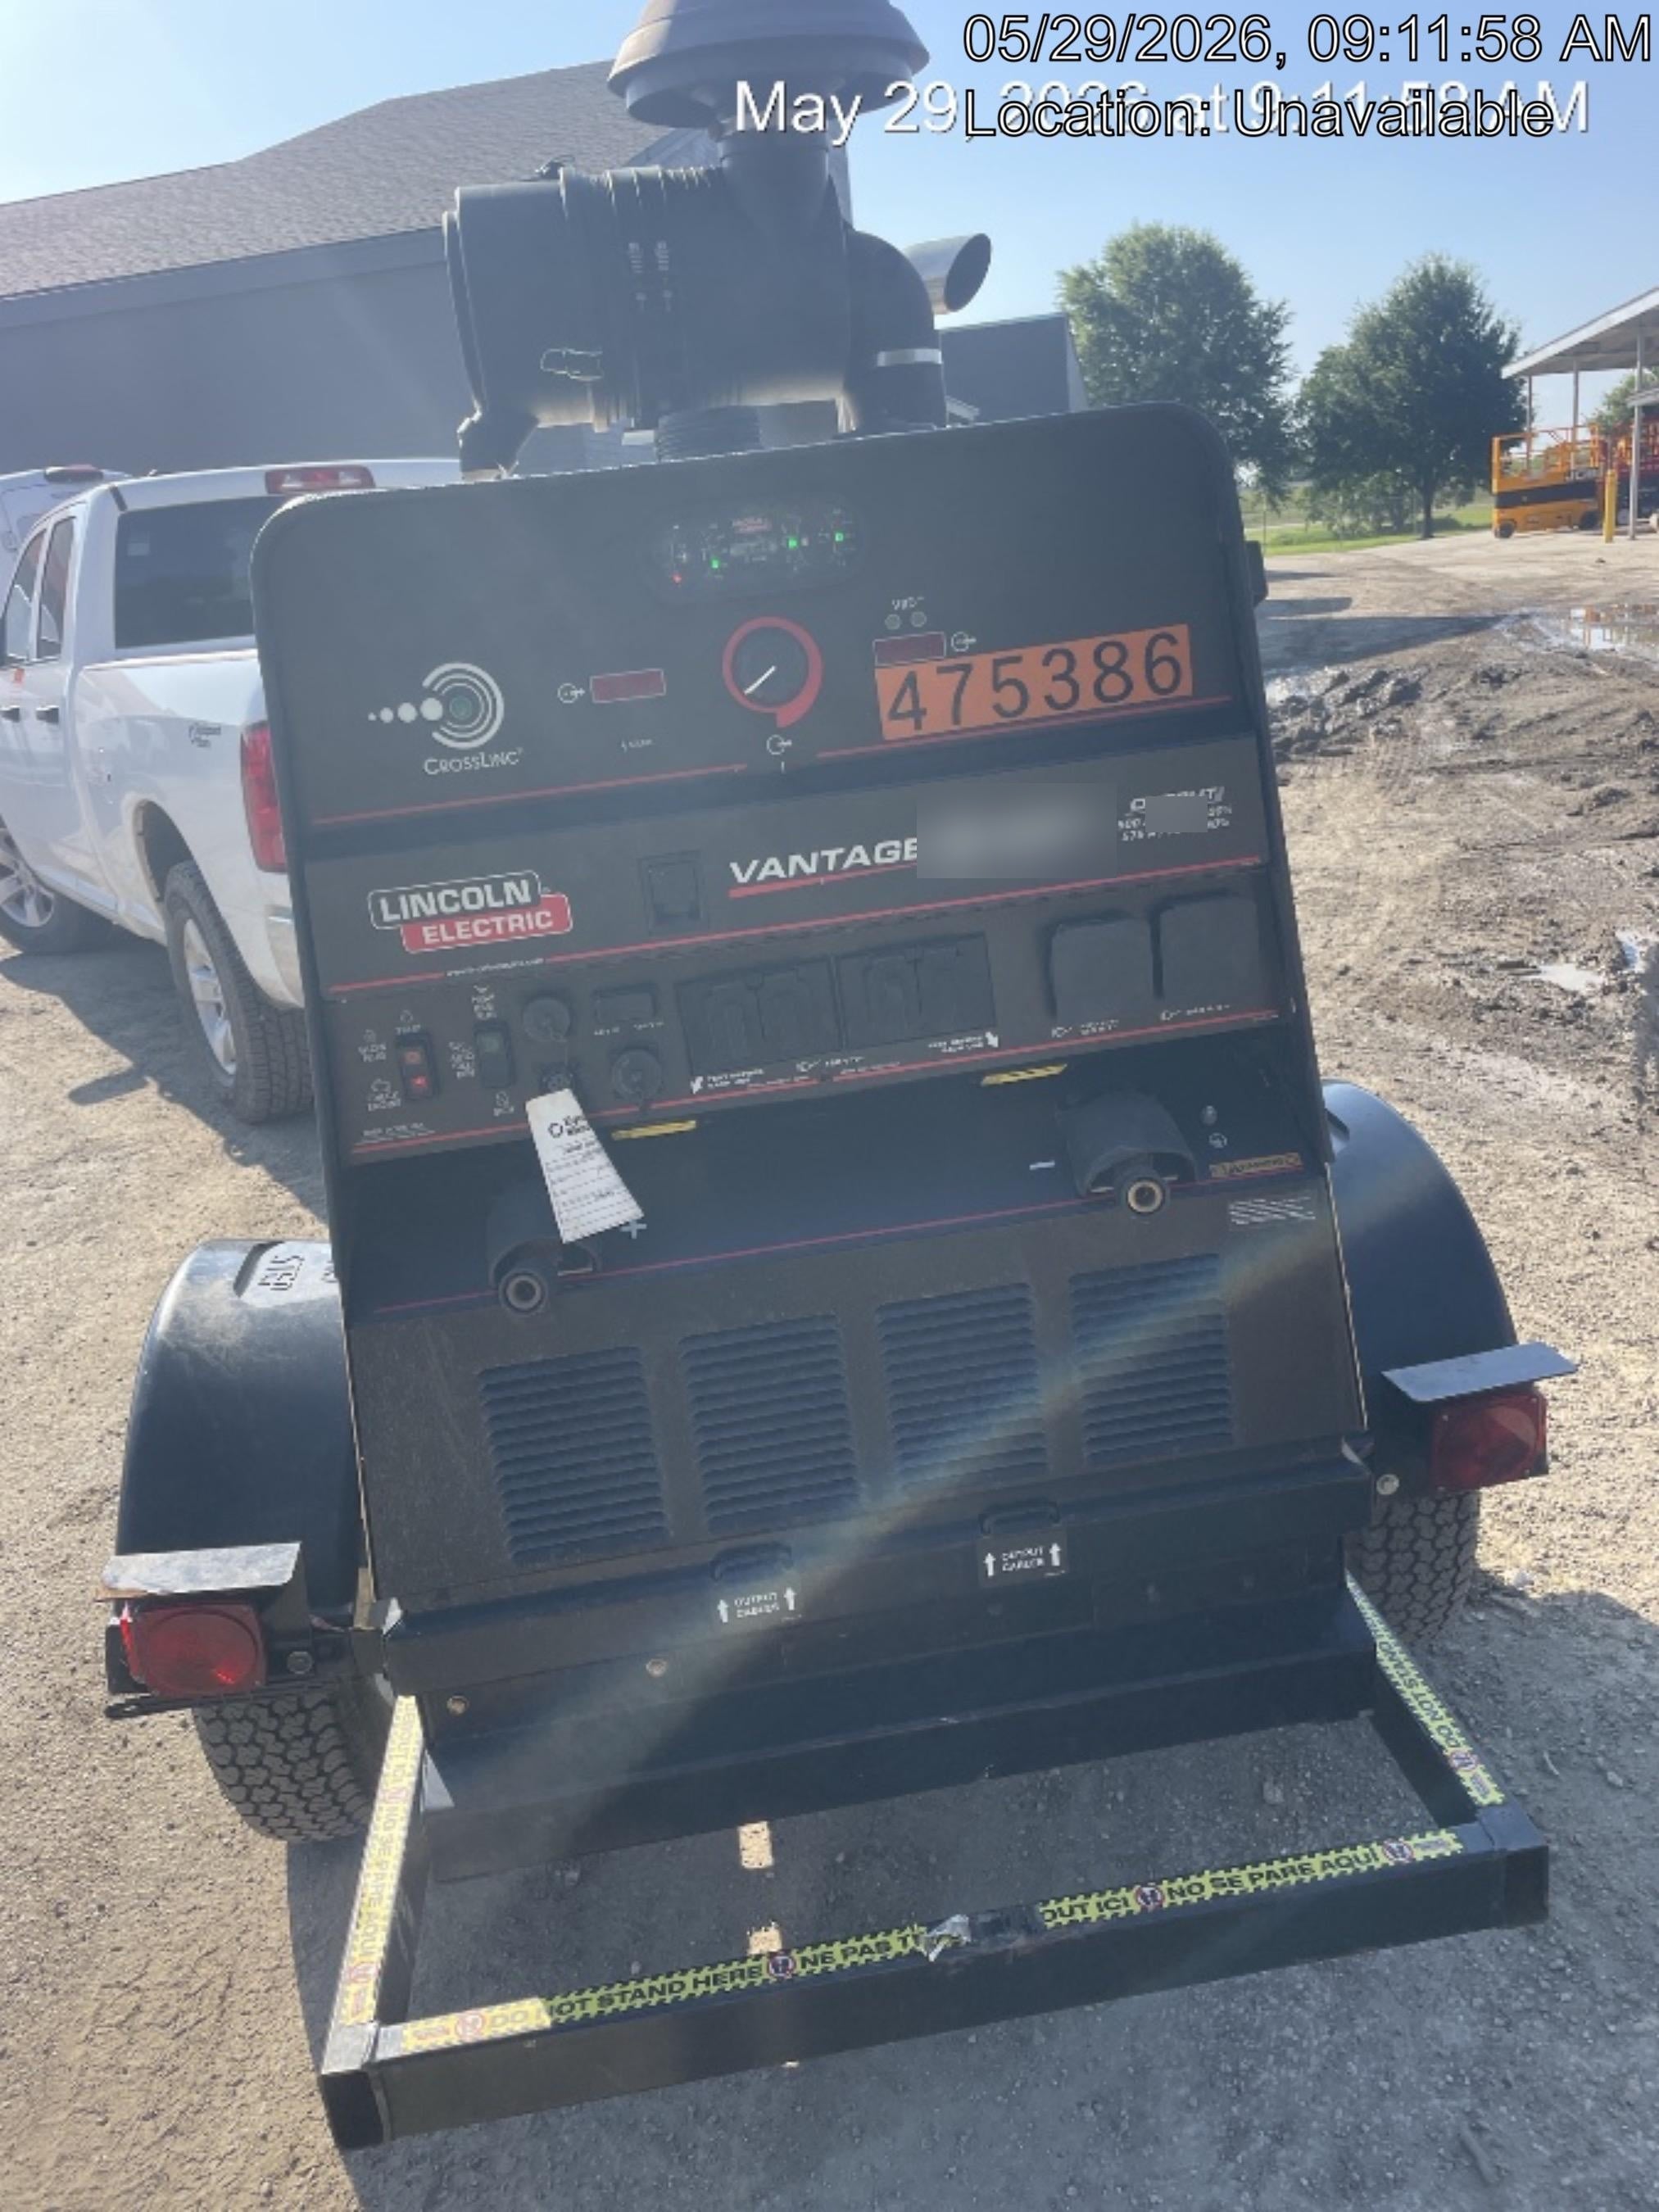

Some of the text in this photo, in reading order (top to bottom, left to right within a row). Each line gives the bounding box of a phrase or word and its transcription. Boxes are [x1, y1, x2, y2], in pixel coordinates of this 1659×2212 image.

[887, 632, 1182, 731] 475386
[729, 837, 918, 884] VANTAGE
[380, 879, 532, 922] LINCOLN
[422, 910, 554, 945] ELECTRIC
[1167, 1882, 1207, 1902] NO
[1210, 1872, 1244, 1892] SE
[1249, 1862, 1317, 1886] PARE
[1096, 1897, 1130, 1913] ICI
[799, 1951, 836, 1969] NE
[491, 1965, 764, 2028] DO NOT STAND HERE
